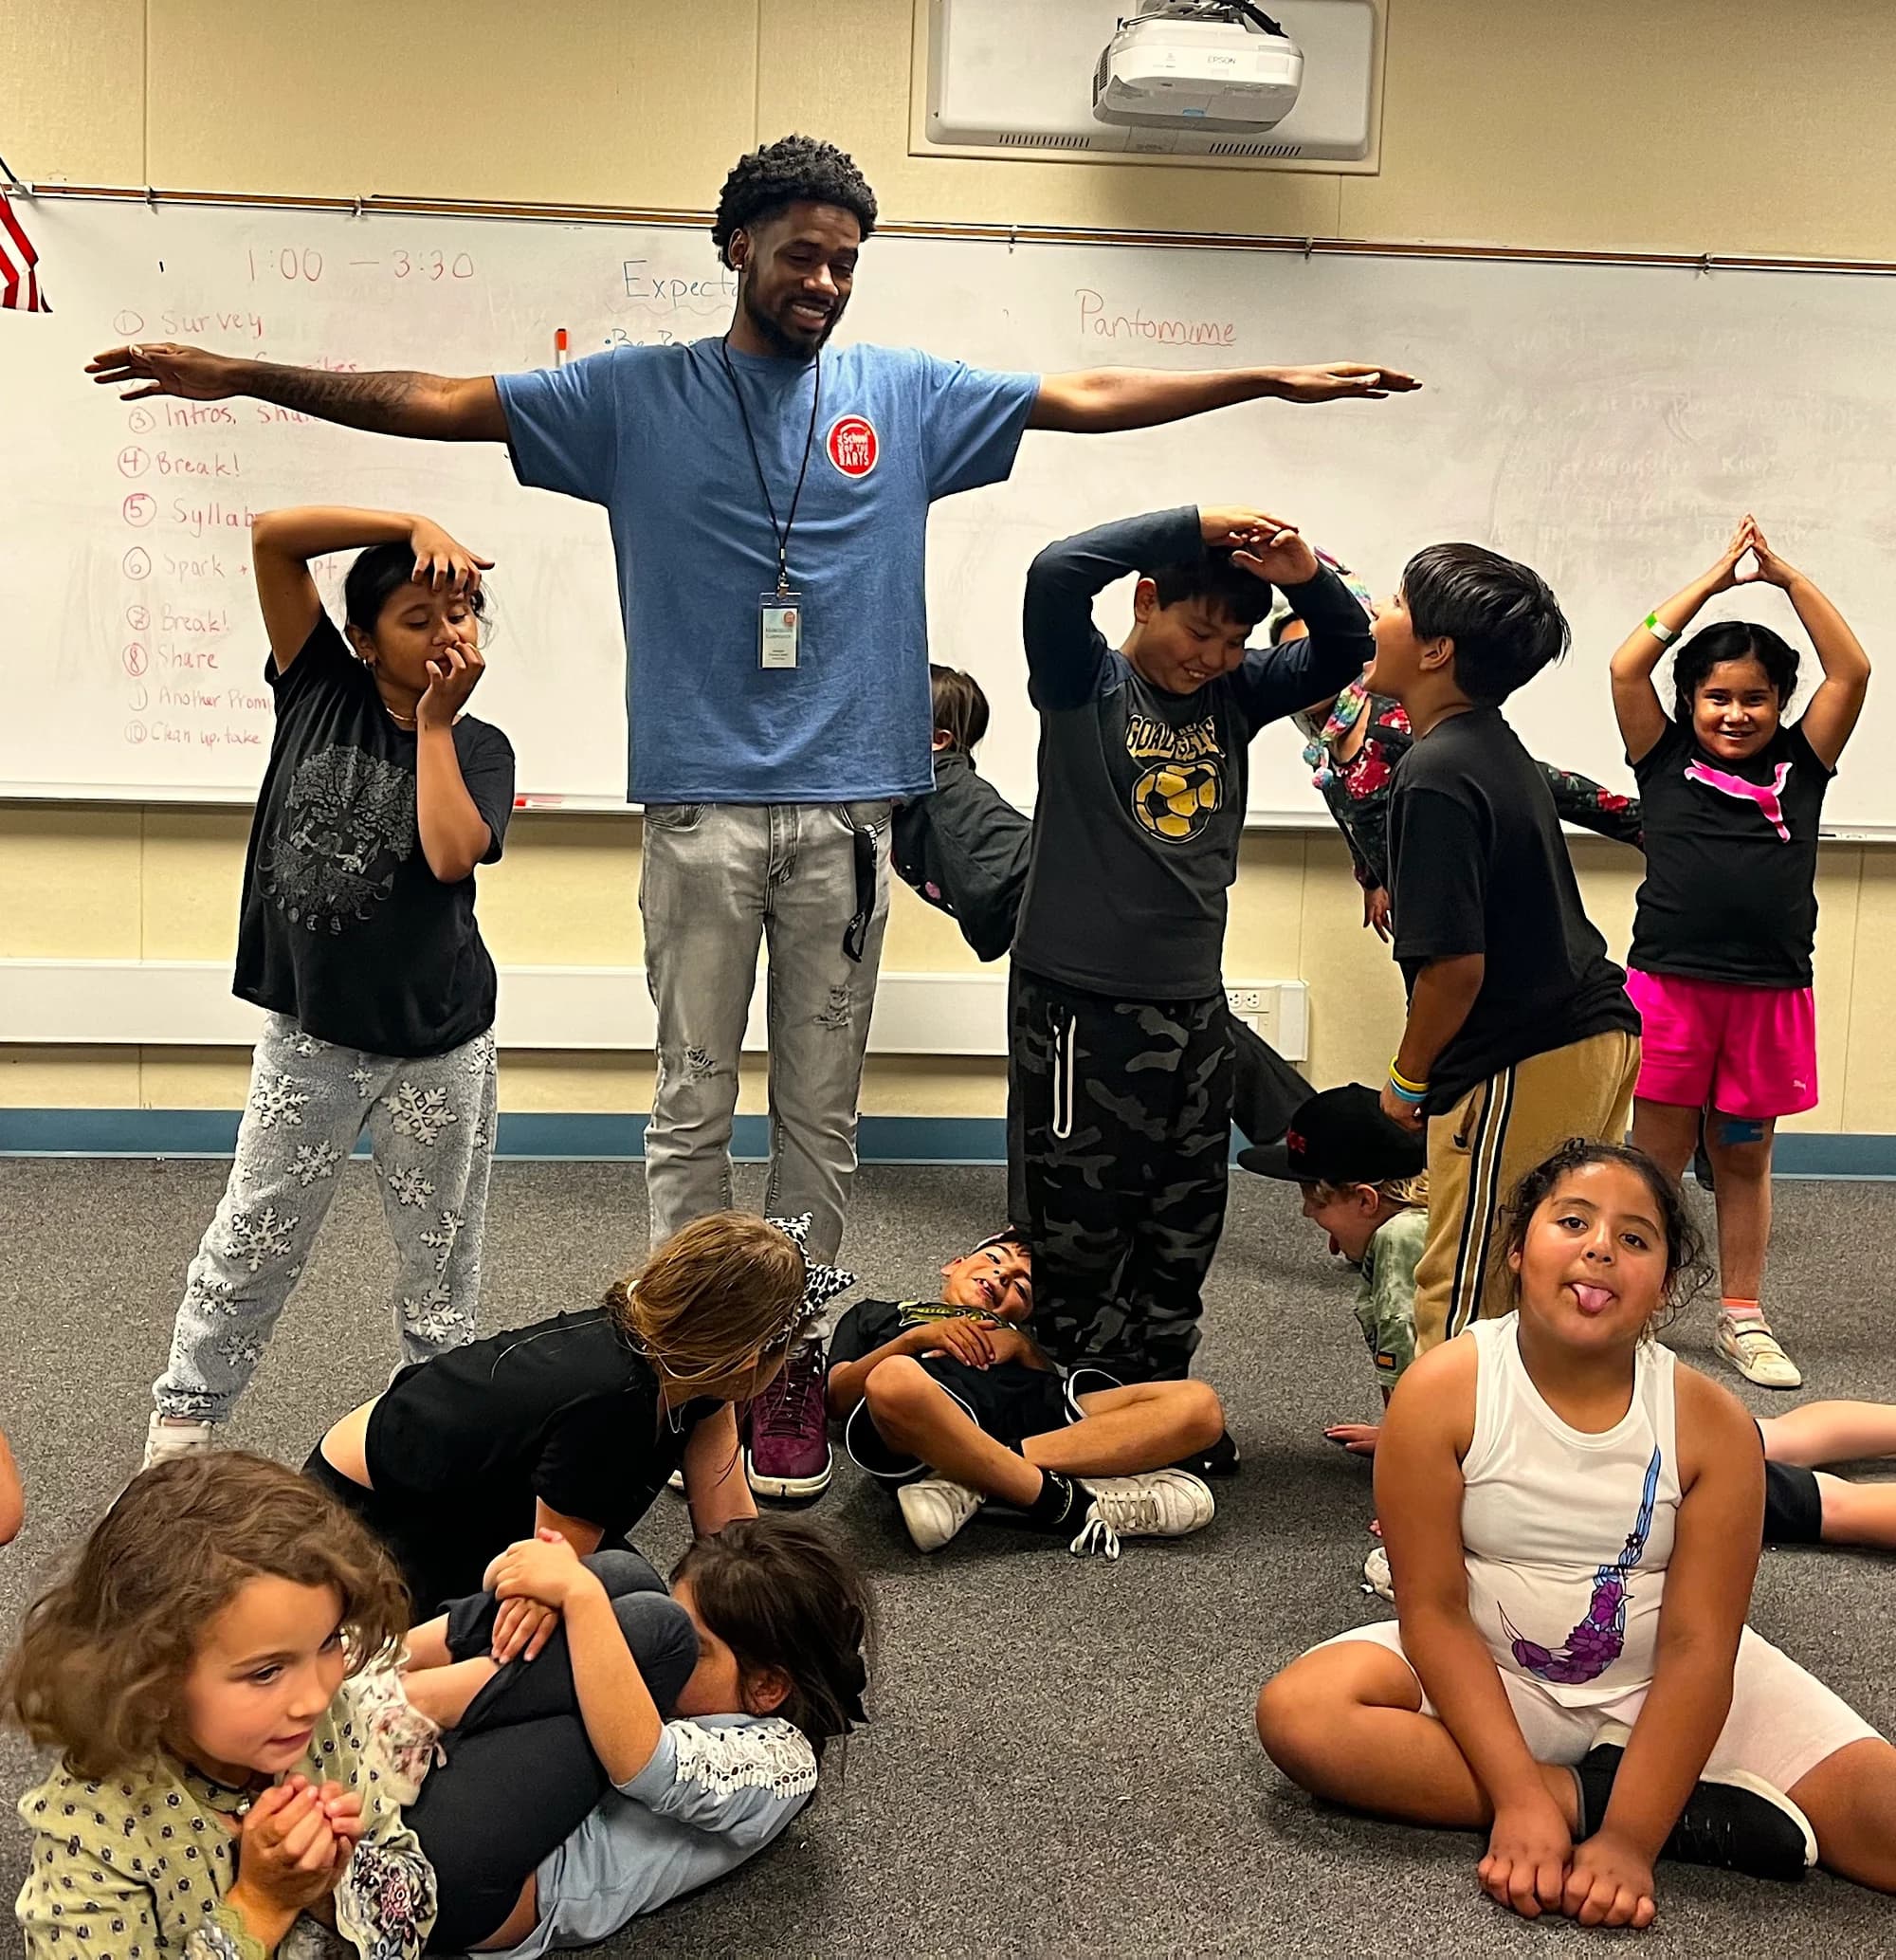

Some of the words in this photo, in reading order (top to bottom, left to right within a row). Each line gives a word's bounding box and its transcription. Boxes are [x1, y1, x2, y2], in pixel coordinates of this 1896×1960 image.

[248, 247, 323, 282] 1:00
[392, 248, 474, 281] 3:30
[162, 309, 263, 339] Survey
[1074, 288, 1237, 343] Pantomime
[256, 405, 320, 424] Sha
[156, 449, 241, 477] Break!
[846, 450, 870, 467] ARTS
[173, 497, 257, 539] Syllab
[163, 553, 227, 584] Spark
[161, 602, 230, 632] Break!
[157, 643, 220, 669] Share
[159, 686, 221, 708] Another
[151, 721, 191, 743] Clean
[225, 726, 261, 744] take
